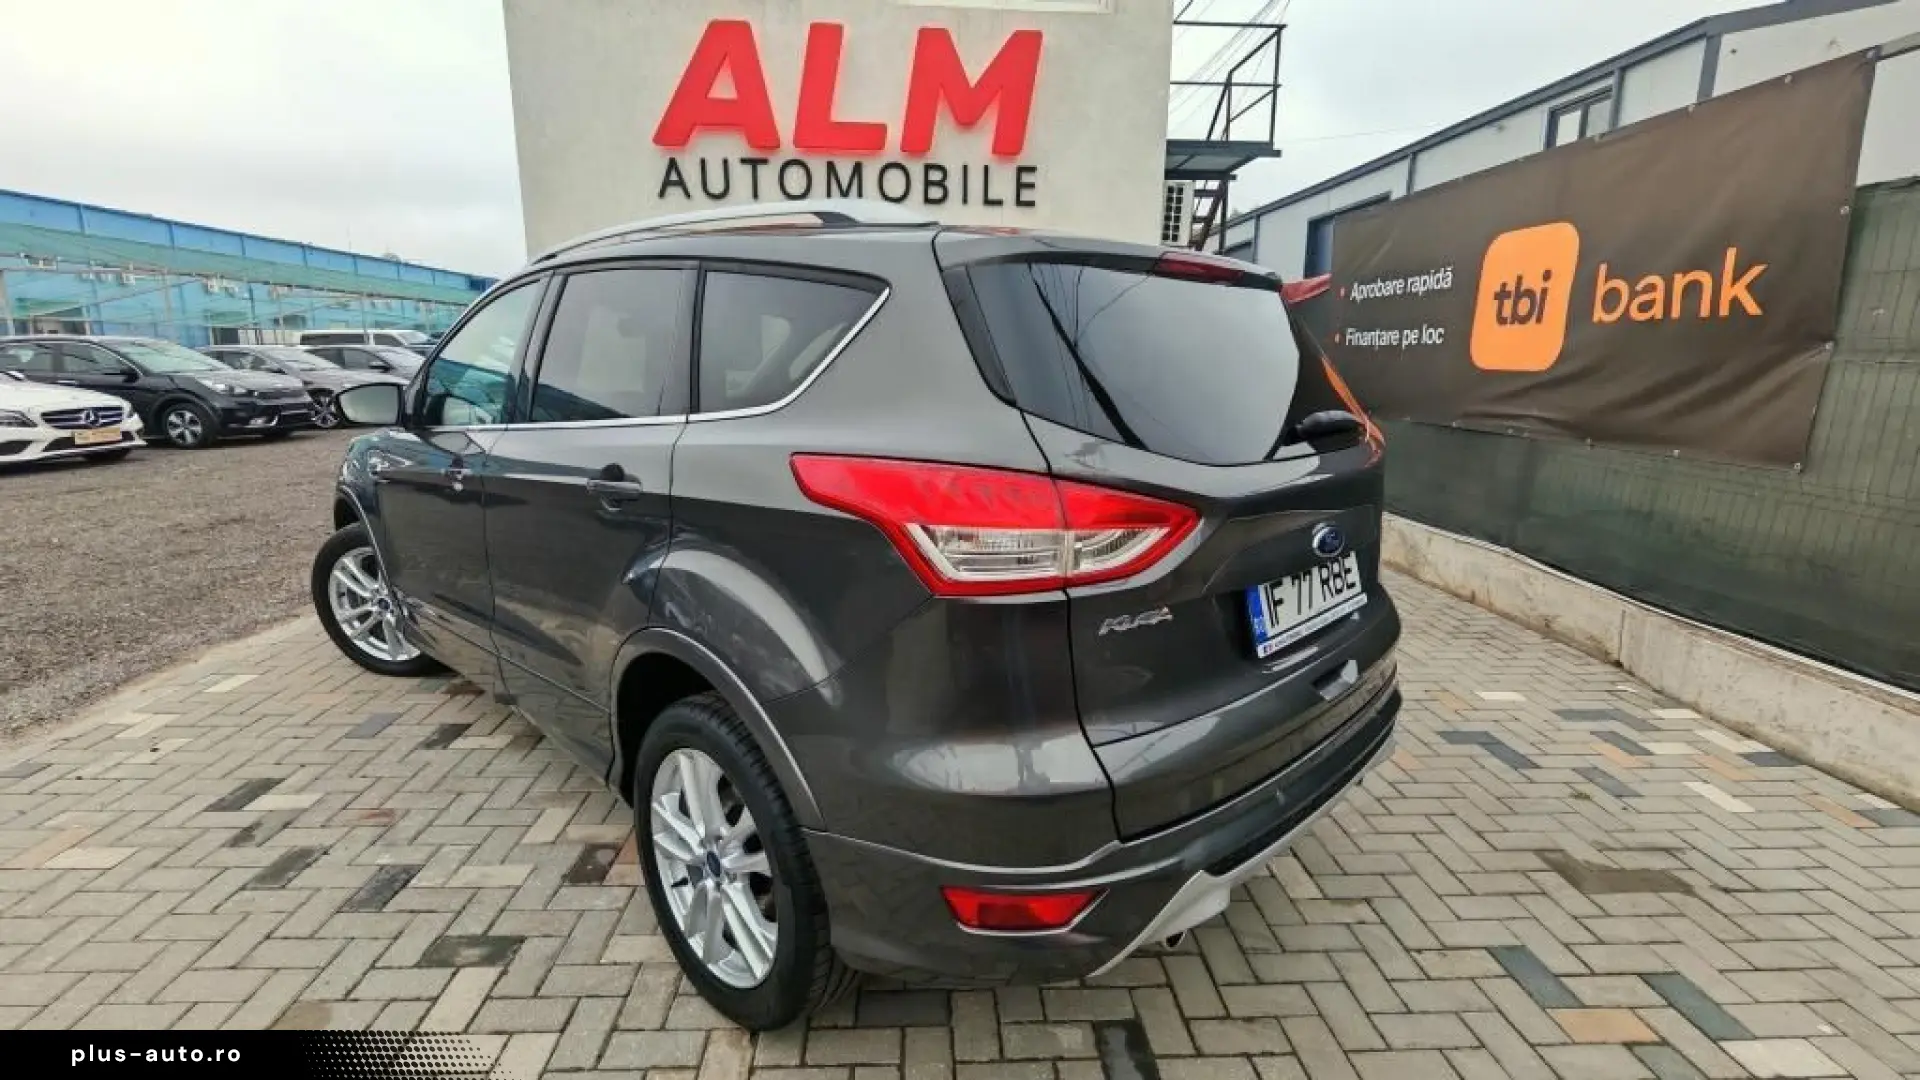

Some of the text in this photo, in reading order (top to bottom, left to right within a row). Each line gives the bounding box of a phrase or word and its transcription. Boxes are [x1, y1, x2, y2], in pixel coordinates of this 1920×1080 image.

[653, 19, 1043, 156] ALM
[658, 157, 1038, 206] AUTOMOBILE
[1350, 266, 1453, 304] Aprobare rapidă
[1494, 247, 1768, 327] tbi bank
[1402, 329, 1419, 350] pe
[1421, 323, 1444, 344] loc
[1264, 580, 1284, 628] IF
[1291, 569, 1313, 616] 77
[1318, 555, 1356, 602] RBE
